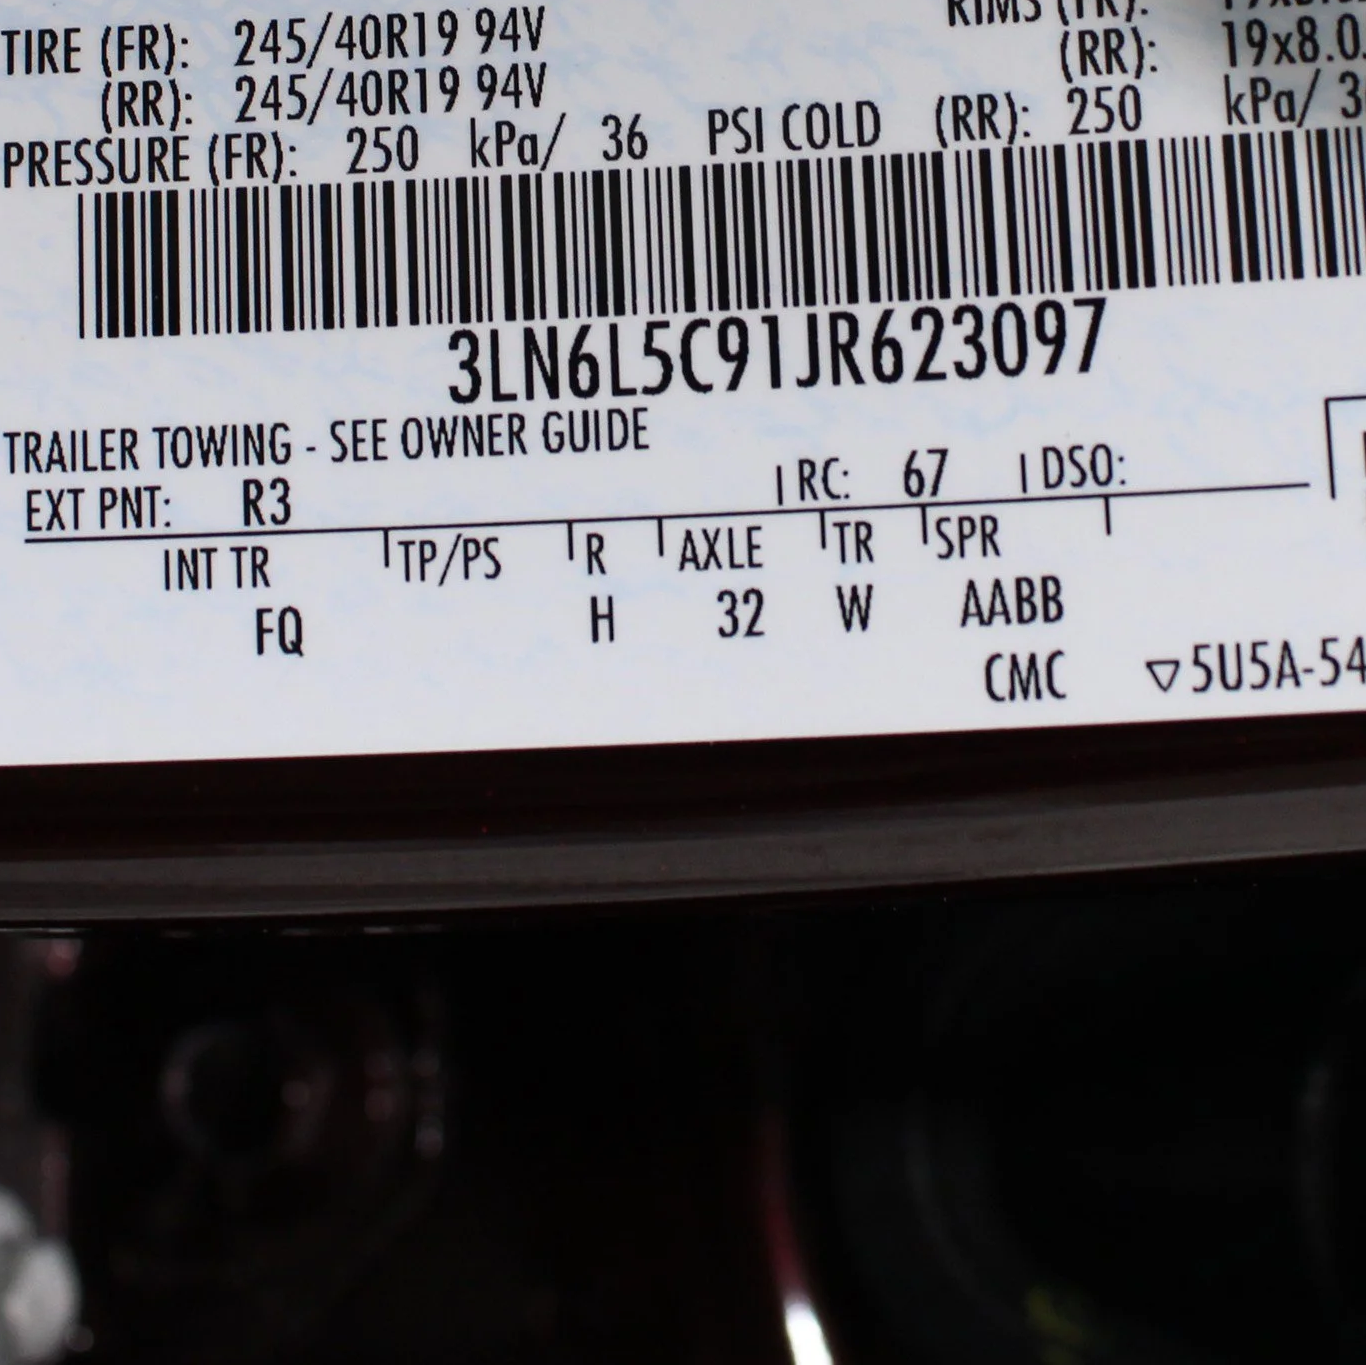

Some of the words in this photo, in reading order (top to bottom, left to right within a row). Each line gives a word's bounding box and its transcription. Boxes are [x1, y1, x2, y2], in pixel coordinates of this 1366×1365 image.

[1, 28, 81, 75] TIRE
[101, 23, 188, 78] (FR):
[234, 9, 458, 69] 245/40R19
[475, 6, 545, 54] 94V
[1060, 26, 1157, 84] (RR):
[102, 78, 192, 134] (RR):
[235, 65, 460, 125] 245/40R19
[477, 62, 546, 111] 94V
[4, 135, 190, 188] PRESSURE
[206, 131, 296, 184] (FR):
[347, 124, 419, 174] 250
[470, 112, 566, 171] kPa/
[602, 114, 648, 161] 36
[708, 106, 764, 155] PSI
[782, 100, 881, 151] COLD
[935, 93, 1030, 149] (RR):
[1067, 84, 1142, 135] 250
[1224, 68, 1321, 128] kPa/
[447, 298, 1107, 403] 3LN6L5C91JR623097
[3, 428, 139, 474] TRAILER
[152, 423, 291, 469] TOWING
[330, 419, 388, 463] SEE
[401, 413, 527, 459] OWNER
[542, 407, 649, 454] GUIDE
[798, 457, 850, 501] RC:
[904, 448, 948, 498] 67
[1042, 444, 1125, 489] DSO:
[27, 488, 85, 532] EXT
[100, 486, 170, 529] PNT:
[243, 477, 291, 526] R3
[397, 533, 501, 586] TP/PS
[679, 526, 763, 571] AXLE
[832, 521, 873, 564] TR
[936, 515, 1000, 559] SPR
[164, 547, 218, 591] INT
[230, 546, 270, 588] TR
[717, 588, 764, 638] 32
[961, 575, 1063, 627] AABB
[256, 606, 304, 657] FQ
[985, 650, 1066, 702] CMC
